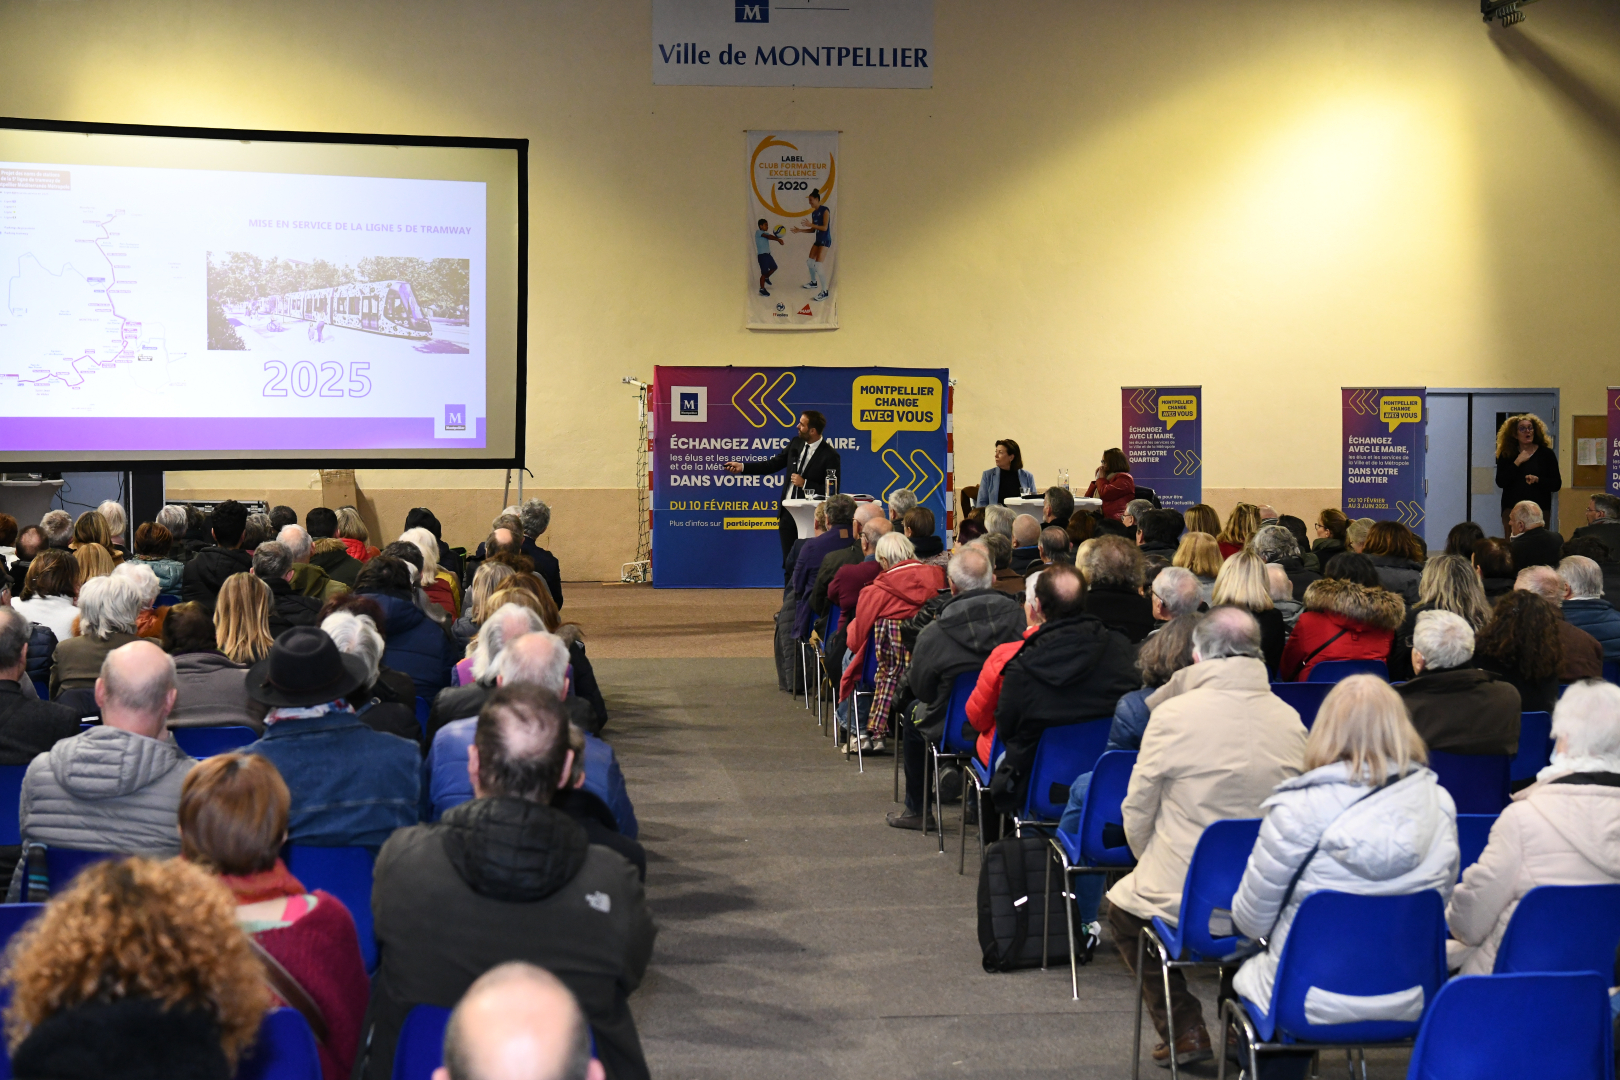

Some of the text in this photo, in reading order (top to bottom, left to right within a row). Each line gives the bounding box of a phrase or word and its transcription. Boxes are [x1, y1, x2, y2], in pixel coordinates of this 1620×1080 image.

[743, 5, 761, 20] M
[658, 43, 928, 68] Ville de MONTPELLIER
[778, 181, 808, 190] 2020
[248, 219, 472, 235] MISE EN SERVICE DE LA LIGNE 5 DE TRAMWAY
[262, 360, 372, 398] 2025
[860, 386, 934, 396] MONTPELLIER
[684, 400, 695, 410] M
[875, 398, 919, 407] CHANGE
[449, 412, 462, 424] M
[862, 410, 934, 422] AVEC VOUS
[670, 434, 790, 450] ÉCHANGEZ AVEC
[826, 438, 860, 450] AIRE,
[1348, 435, 1392, 444] ÉCHANGEZ
[670, 475, 710, 486] DANS
[714, 475, 760, 486] VOTRE
[670, 499, 778, 510] DU 10 FÉVRIER AU 3
